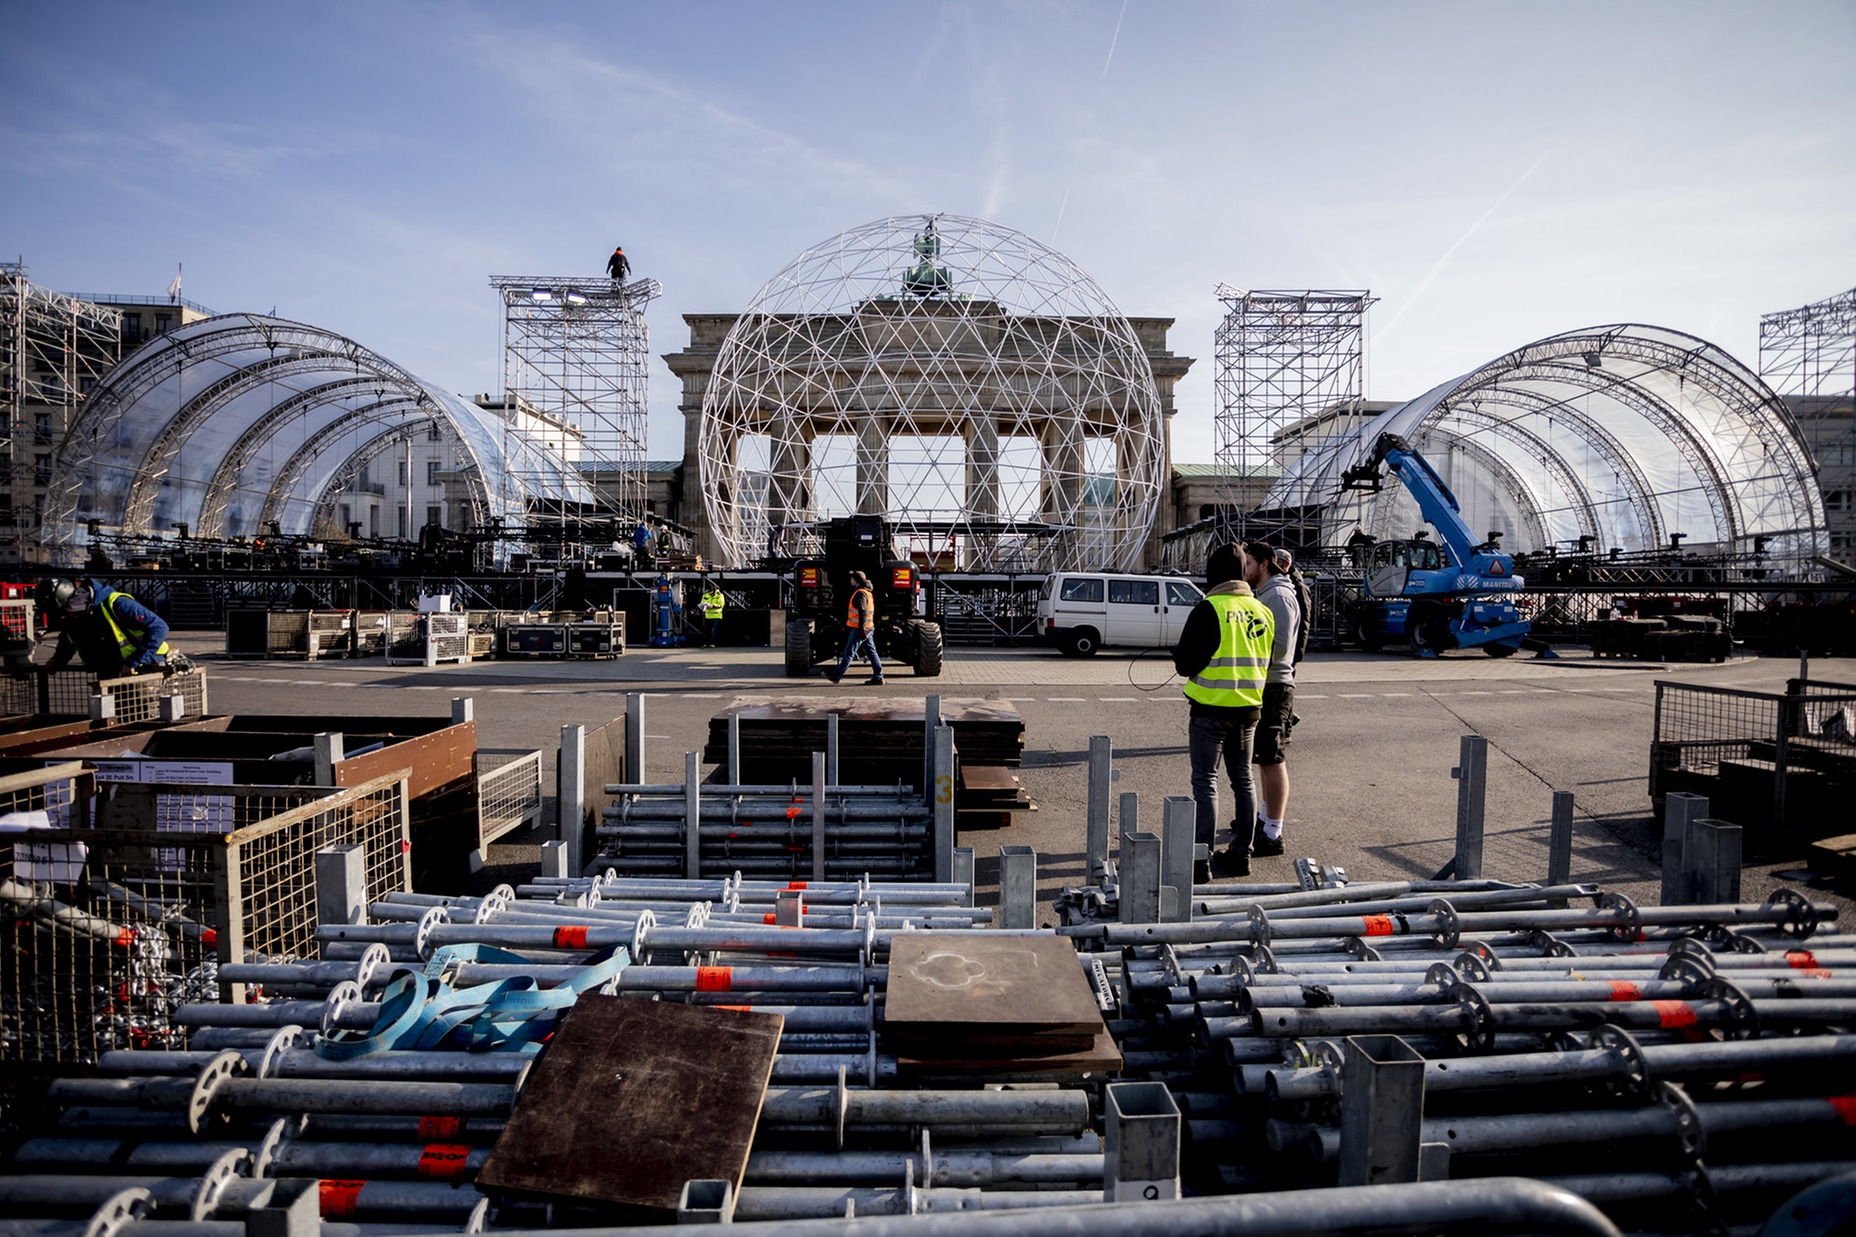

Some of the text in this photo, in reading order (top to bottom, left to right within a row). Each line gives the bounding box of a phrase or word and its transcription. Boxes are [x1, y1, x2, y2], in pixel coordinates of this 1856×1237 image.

[1482, 581, 1514, 589] MANITOU
[1226, 610, 1254, 624] PRG
[936, 774, 954, 804] 3
[1093, 963, 1114, 1007] MEGAFORCE
